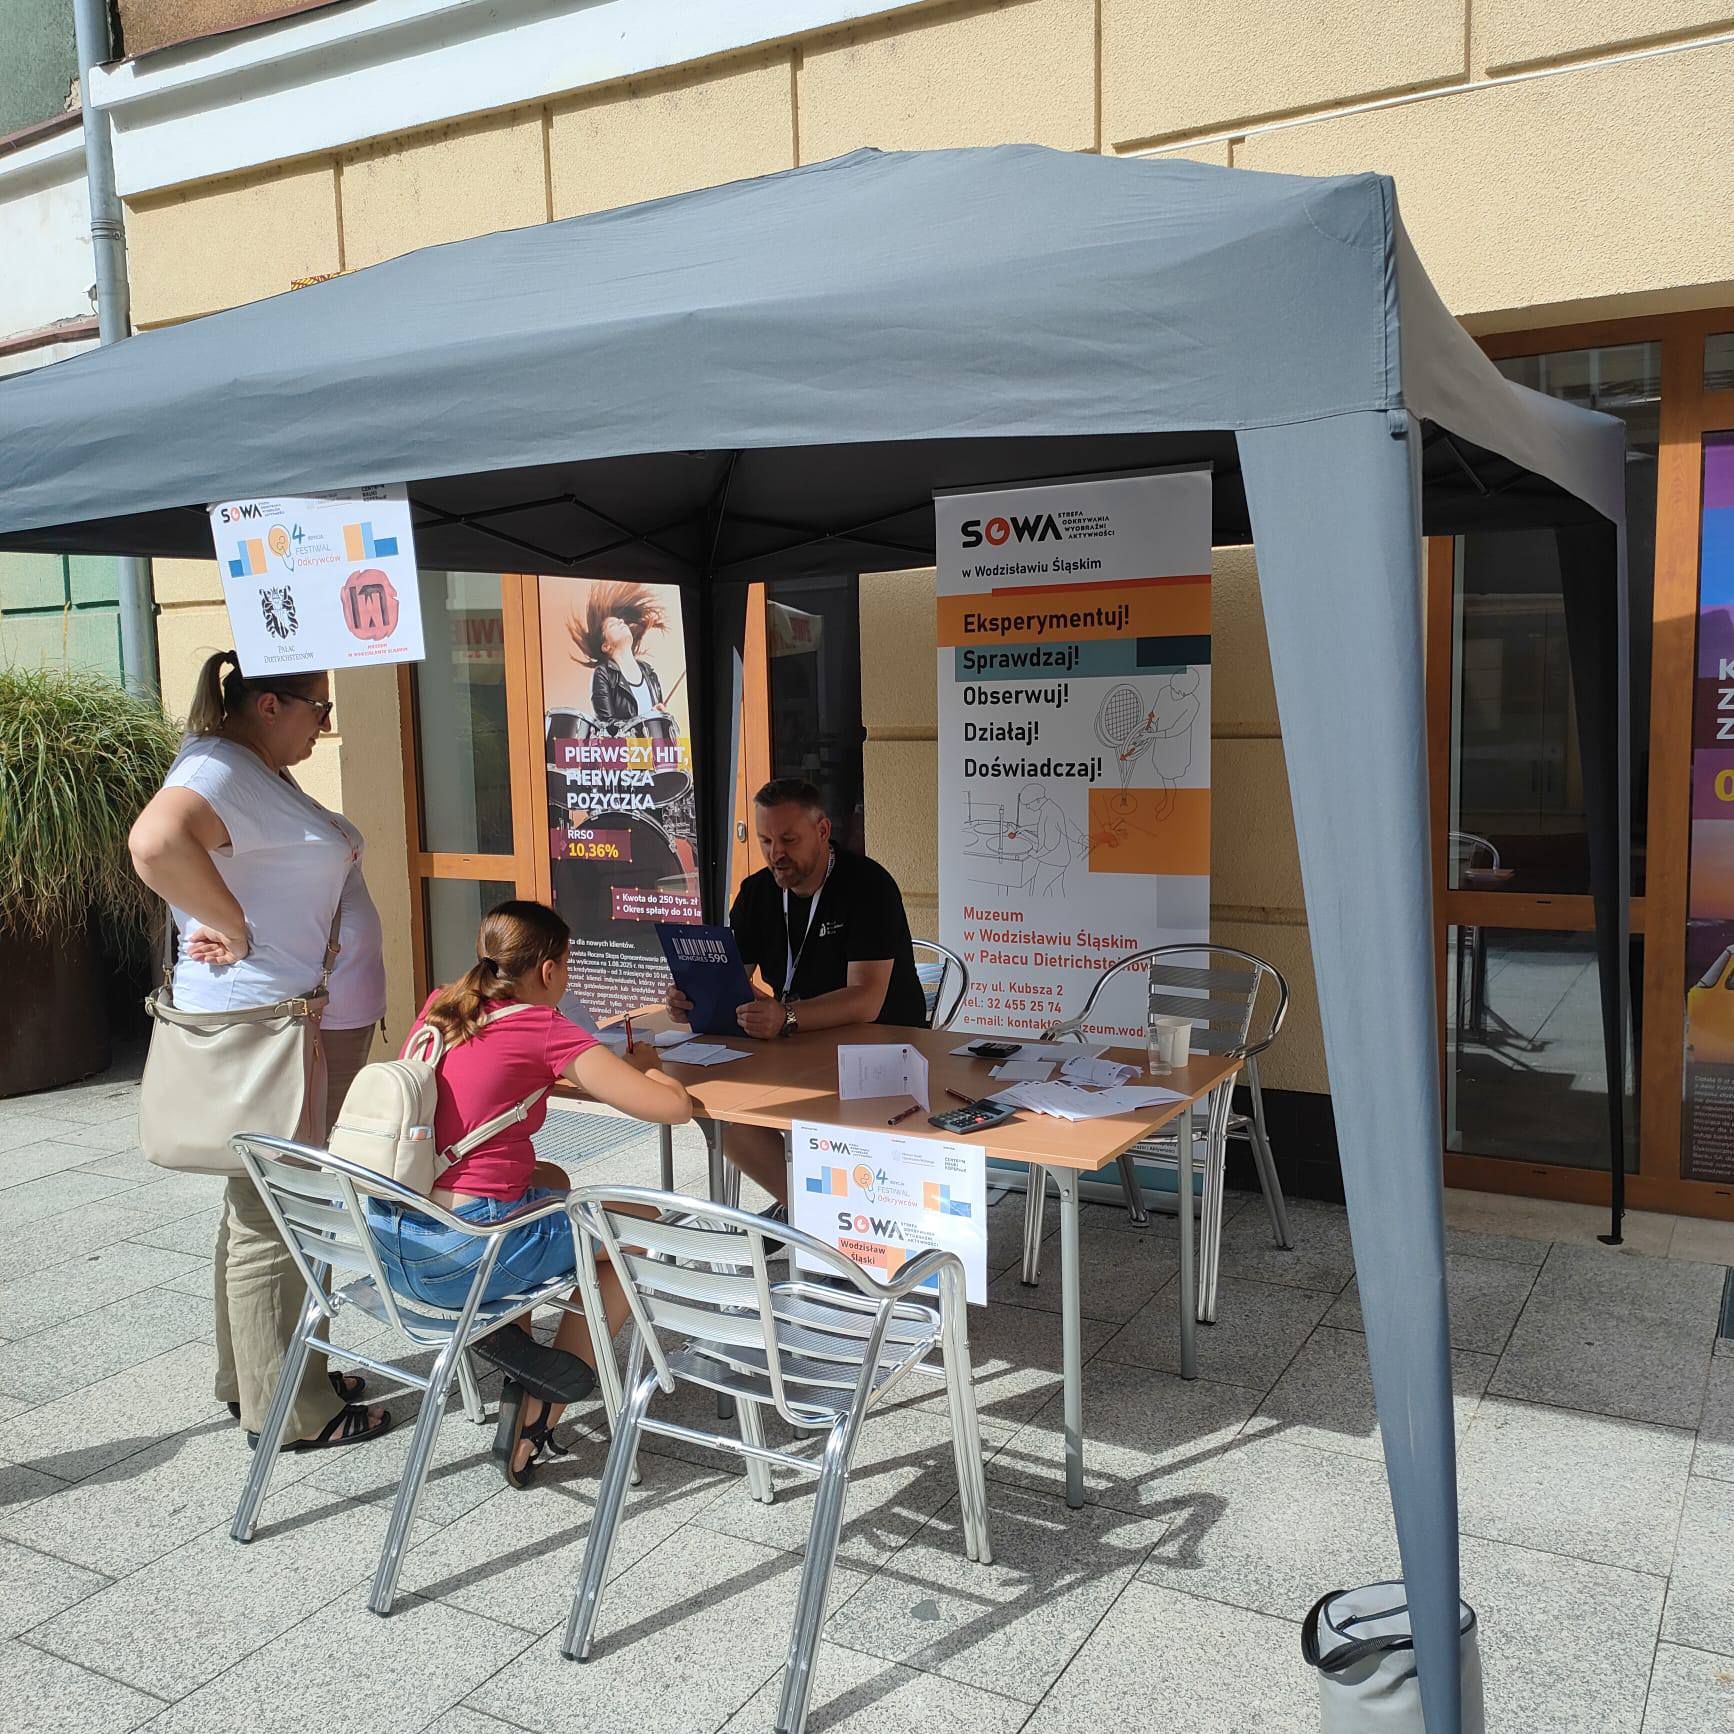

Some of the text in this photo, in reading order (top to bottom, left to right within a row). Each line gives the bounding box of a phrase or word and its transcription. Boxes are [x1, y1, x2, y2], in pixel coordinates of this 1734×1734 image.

[221, 503, 262, 523] SOWA
[1062, 516, 1110, 525] ODKRYWANIA
[292, 524, 306, 545] 4
[961, 514, 1063, 548] SOWA
[1065, 523, 1107, 531] WYOBRAŹNI
[1068, 530, 1115, 539] AKTYWNOŚCI
[296, 544, 331, 555] FESTIWAL
[298, 553, 341, 566] Odkrywców
[962, 556, 1101, 578] w Wodzisławiu Śląskim
[964, 604, 1130, 636] Eksperymentuj!
[963, 645, 1079, 674] Sprawdzaj!
[963, 683, 1068, 708] Obserwuj!
[964, 721, 1039, 745] Działaj!
[565, 746, 689, 766] PIERWSZY HIT,
[964, 756, 1102, 782] Doświadczaj!
[566, 770, 654, 787] PIERWSZA
[567, 789, 656, 810] POŻYCZKA
[567, 830, 594, 840] RRSO
[568, 843, 619, 859] 10,36%
[622, 893, 645, 903] Kwota
[647, 894, 657, 903] do
[659, 895, 673, 904] 250
[675, 896, 689, 906] tys.
[623, 904, 644, 914] Okres
[646, 906, 669, 916] spłaty
[671, 907, 681, 916] do
[682, 908, 692, 916] 10
[963, 906, 1024, 922] Muzeum
[963, 928, 1138, 951] w Wodzisławiu Śląskim
[708, 953, 728, 964] 590
[963, 952, 975, 962] w
[980, 950, 1028, 966] Pałacu
[970, 982, 1063, 996] rzy ul. Kubsza 2
[987, 998, 1000, 1009] 32
[1004, 999, 1026, 1010] 455
[1030, 1000, 1044, 1012] 25
[1048, 1001, 1062, 1013] 74
[964, 1015, 1004, 1026] e-mail:
[809, 1138, 851, 1155] SOWA
[876, 1168, 888, 1185] 4
[878, 1195, 917, 1207] Odkrywców
[838, 1212, 904, 1241] SOWA
[840, 1239, 886, 1254] Wodzisław
[851, 1251, 875, 1264] Śląski
